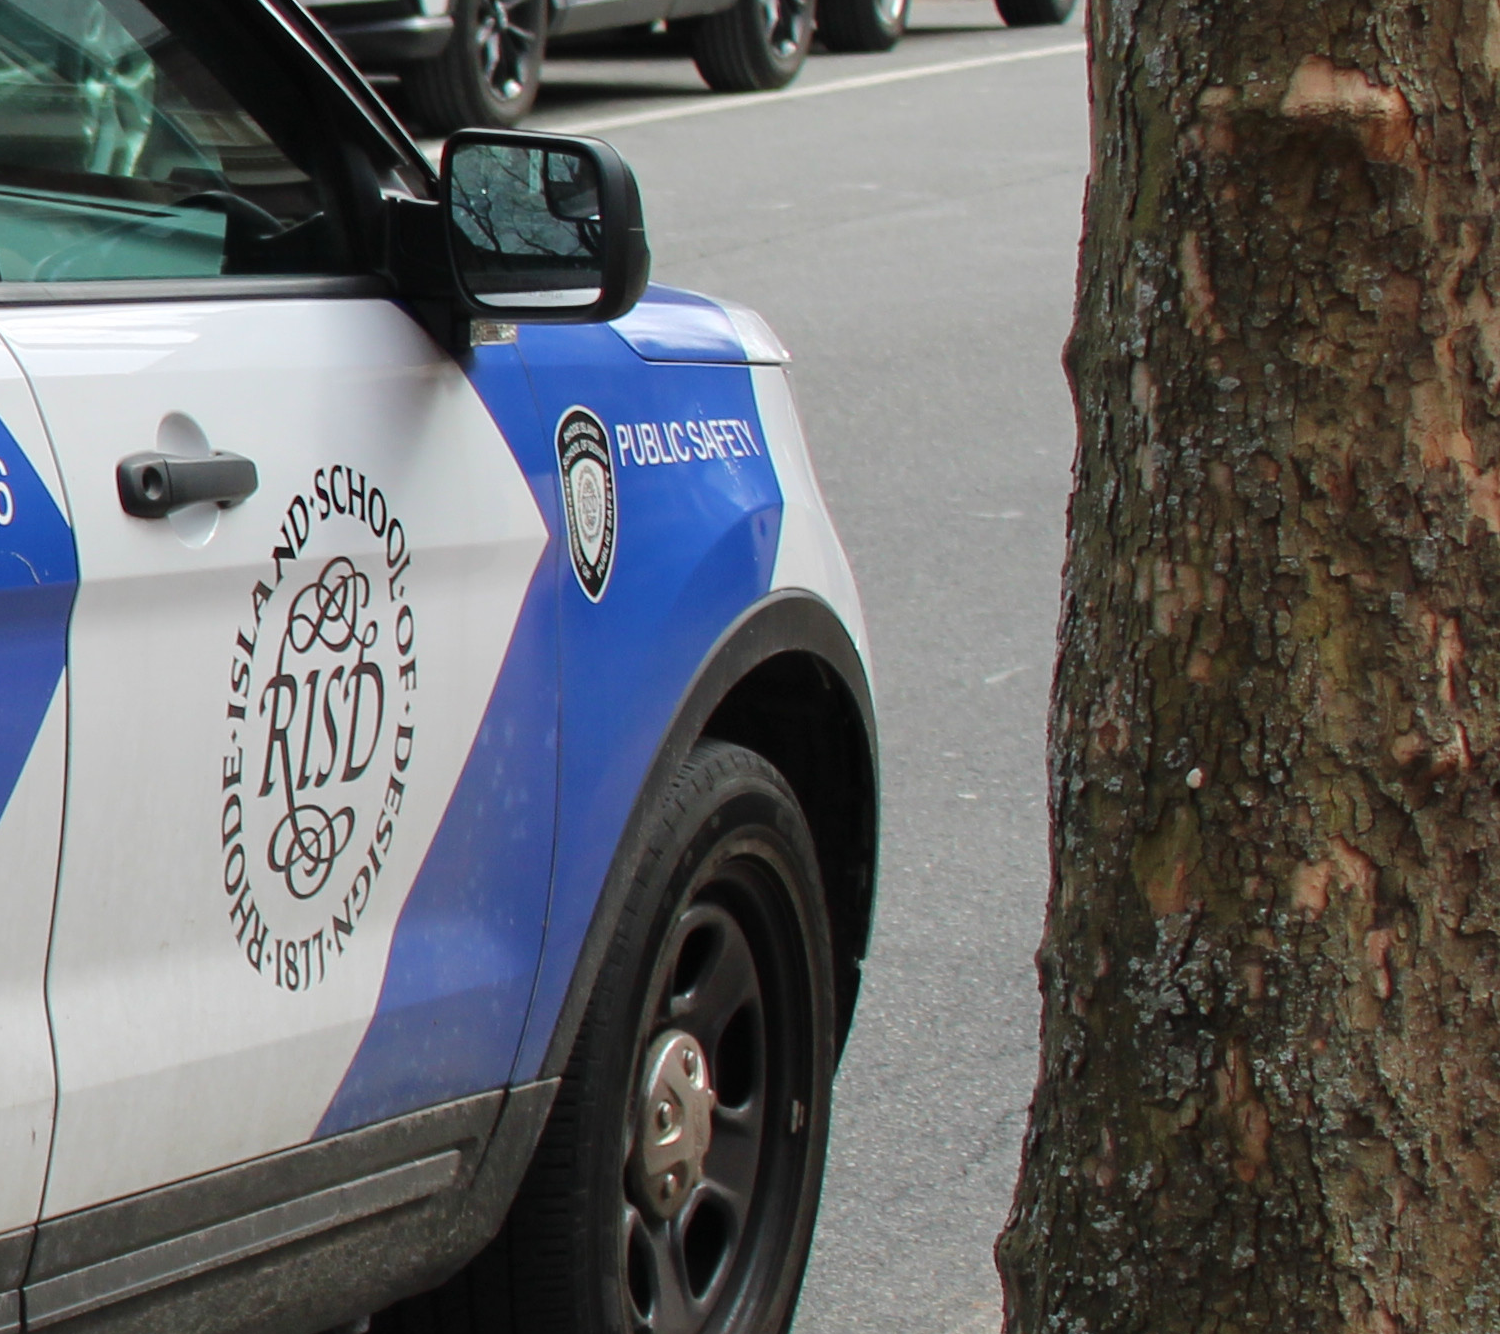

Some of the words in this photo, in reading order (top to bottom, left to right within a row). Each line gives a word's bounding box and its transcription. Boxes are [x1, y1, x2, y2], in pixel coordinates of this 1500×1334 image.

[615, 421, 691, 467] PUBLIC
[686, 419, 761, 461] SAFETY
[313, 464, 411, 602] SCHOOL
[226, 494, 310, 722] ISLAND
[395, 604, 418, 692] OF
[256, 660, 386, 798] RISD
[222, 746, 269, 975] RHODE
[331, 721, 415, 957] DESIGN
